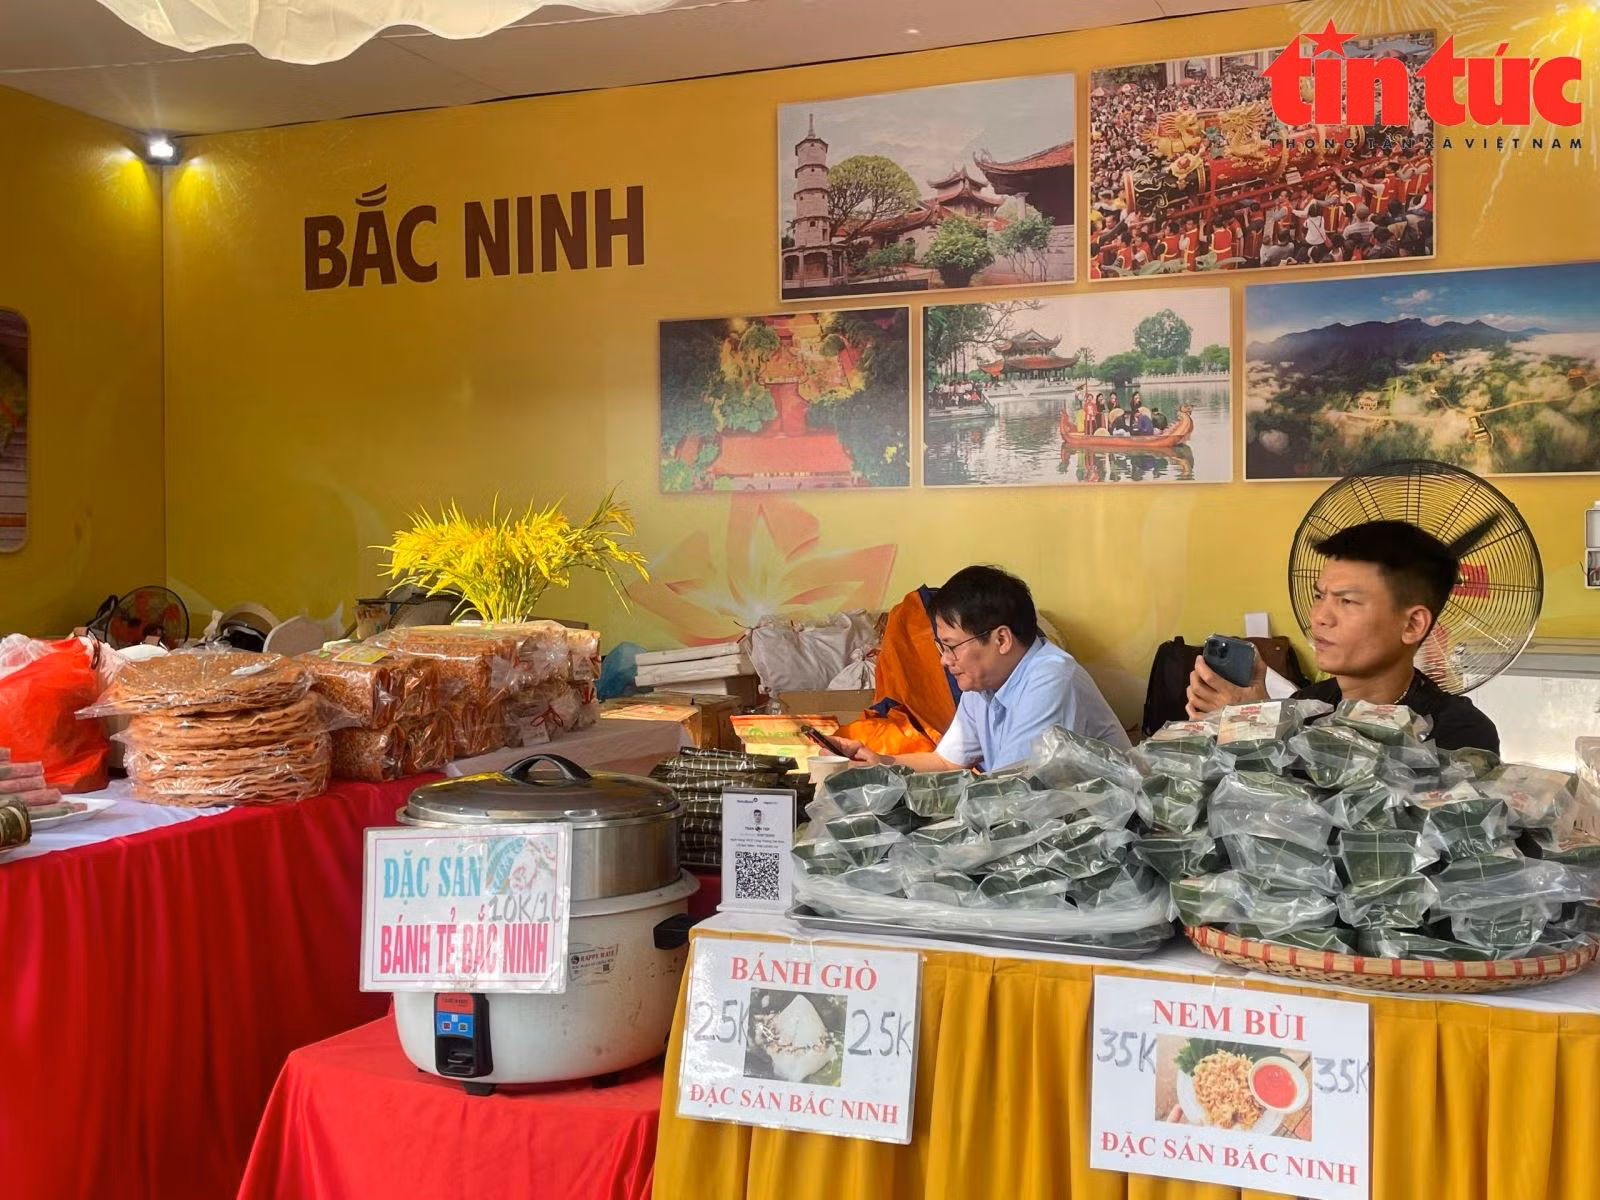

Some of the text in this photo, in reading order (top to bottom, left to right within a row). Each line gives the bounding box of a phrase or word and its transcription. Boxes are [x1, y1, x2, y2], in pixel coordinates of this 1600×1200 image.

[304, 183, 645, 290] BẮC NINH
[383, 844, 482, 905] ĐẶC SẢN
[380, 914, 431, 974] BÁNH
[462, 904, 498, 974] BẮC
[503, 923, 549, 974] NINH
[730, 952, 878, 991] BÁNH GIÒ
[848, 1009, 913, 1057] 25K
[1152, 999, 1307, 1042] NEM BÙI
[1096, 1028, 1157, 1074] 35K
[1314, 1056, 1369, 1094] 35K
[689, 1083, 900, 1125] ĐẶC SẢN BẮC NINH
[1101, 1131, 1359, 1185] ĐẶC SẢN BẮC NINH
